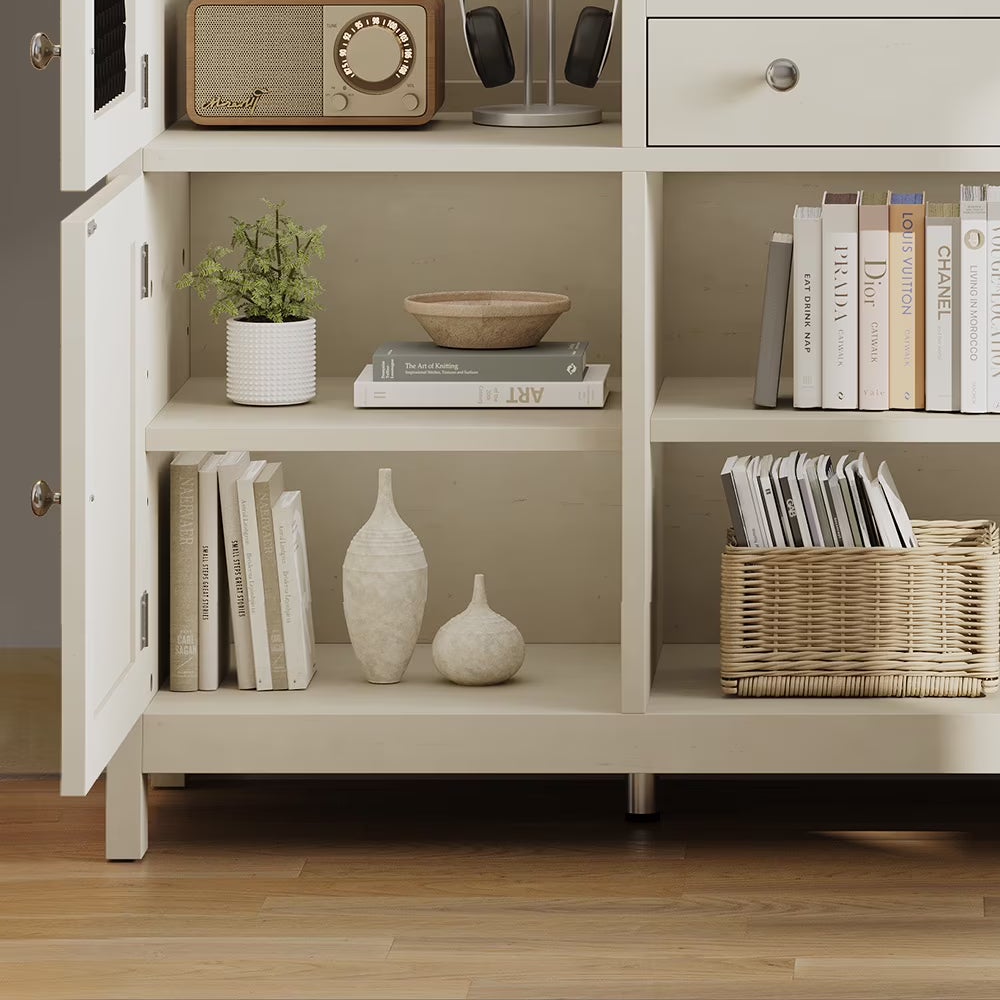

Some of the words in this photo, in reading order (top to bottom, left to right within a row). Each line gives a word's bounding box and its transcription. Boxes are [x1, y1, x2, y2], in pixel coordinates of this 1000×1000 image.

[901, 212, 913, 253] LOUIS
[803, 273, 811, 292] EAT
[834, 246, 849, 322] PRADA
[863, 257, 887, 307] Dior
[901, 257, 913, 315] VUITTON
[937, 245, 951, 321] CHANEL
[969, 265, 978, 296] LIVING
[803, 296, 811, 328] DRINK
[969, 298, 978, 309] IN
[803, 332, 811, 353] NAP
[870, 321, 878, 363] CATWALK
[969, 310, 978, 362] MOROCCO
[435, 363, 459, 371] Knitting
[506, 386, 544, 404] ART
[179, 476, 194, 545] NAERVAER
[201, 545, 209, 562] SMALL
[231, 540, 240, 558] SMALL
[201, 564, 209, 580] STEPS
[233, 559, 242, 576] STEPS
[201, 581, 209, 598] GREAT
[235, 577, 244, 594] GREAT
[201, 599, 209, 621] STORIES
[237, 595, 246, 617] STORIES
